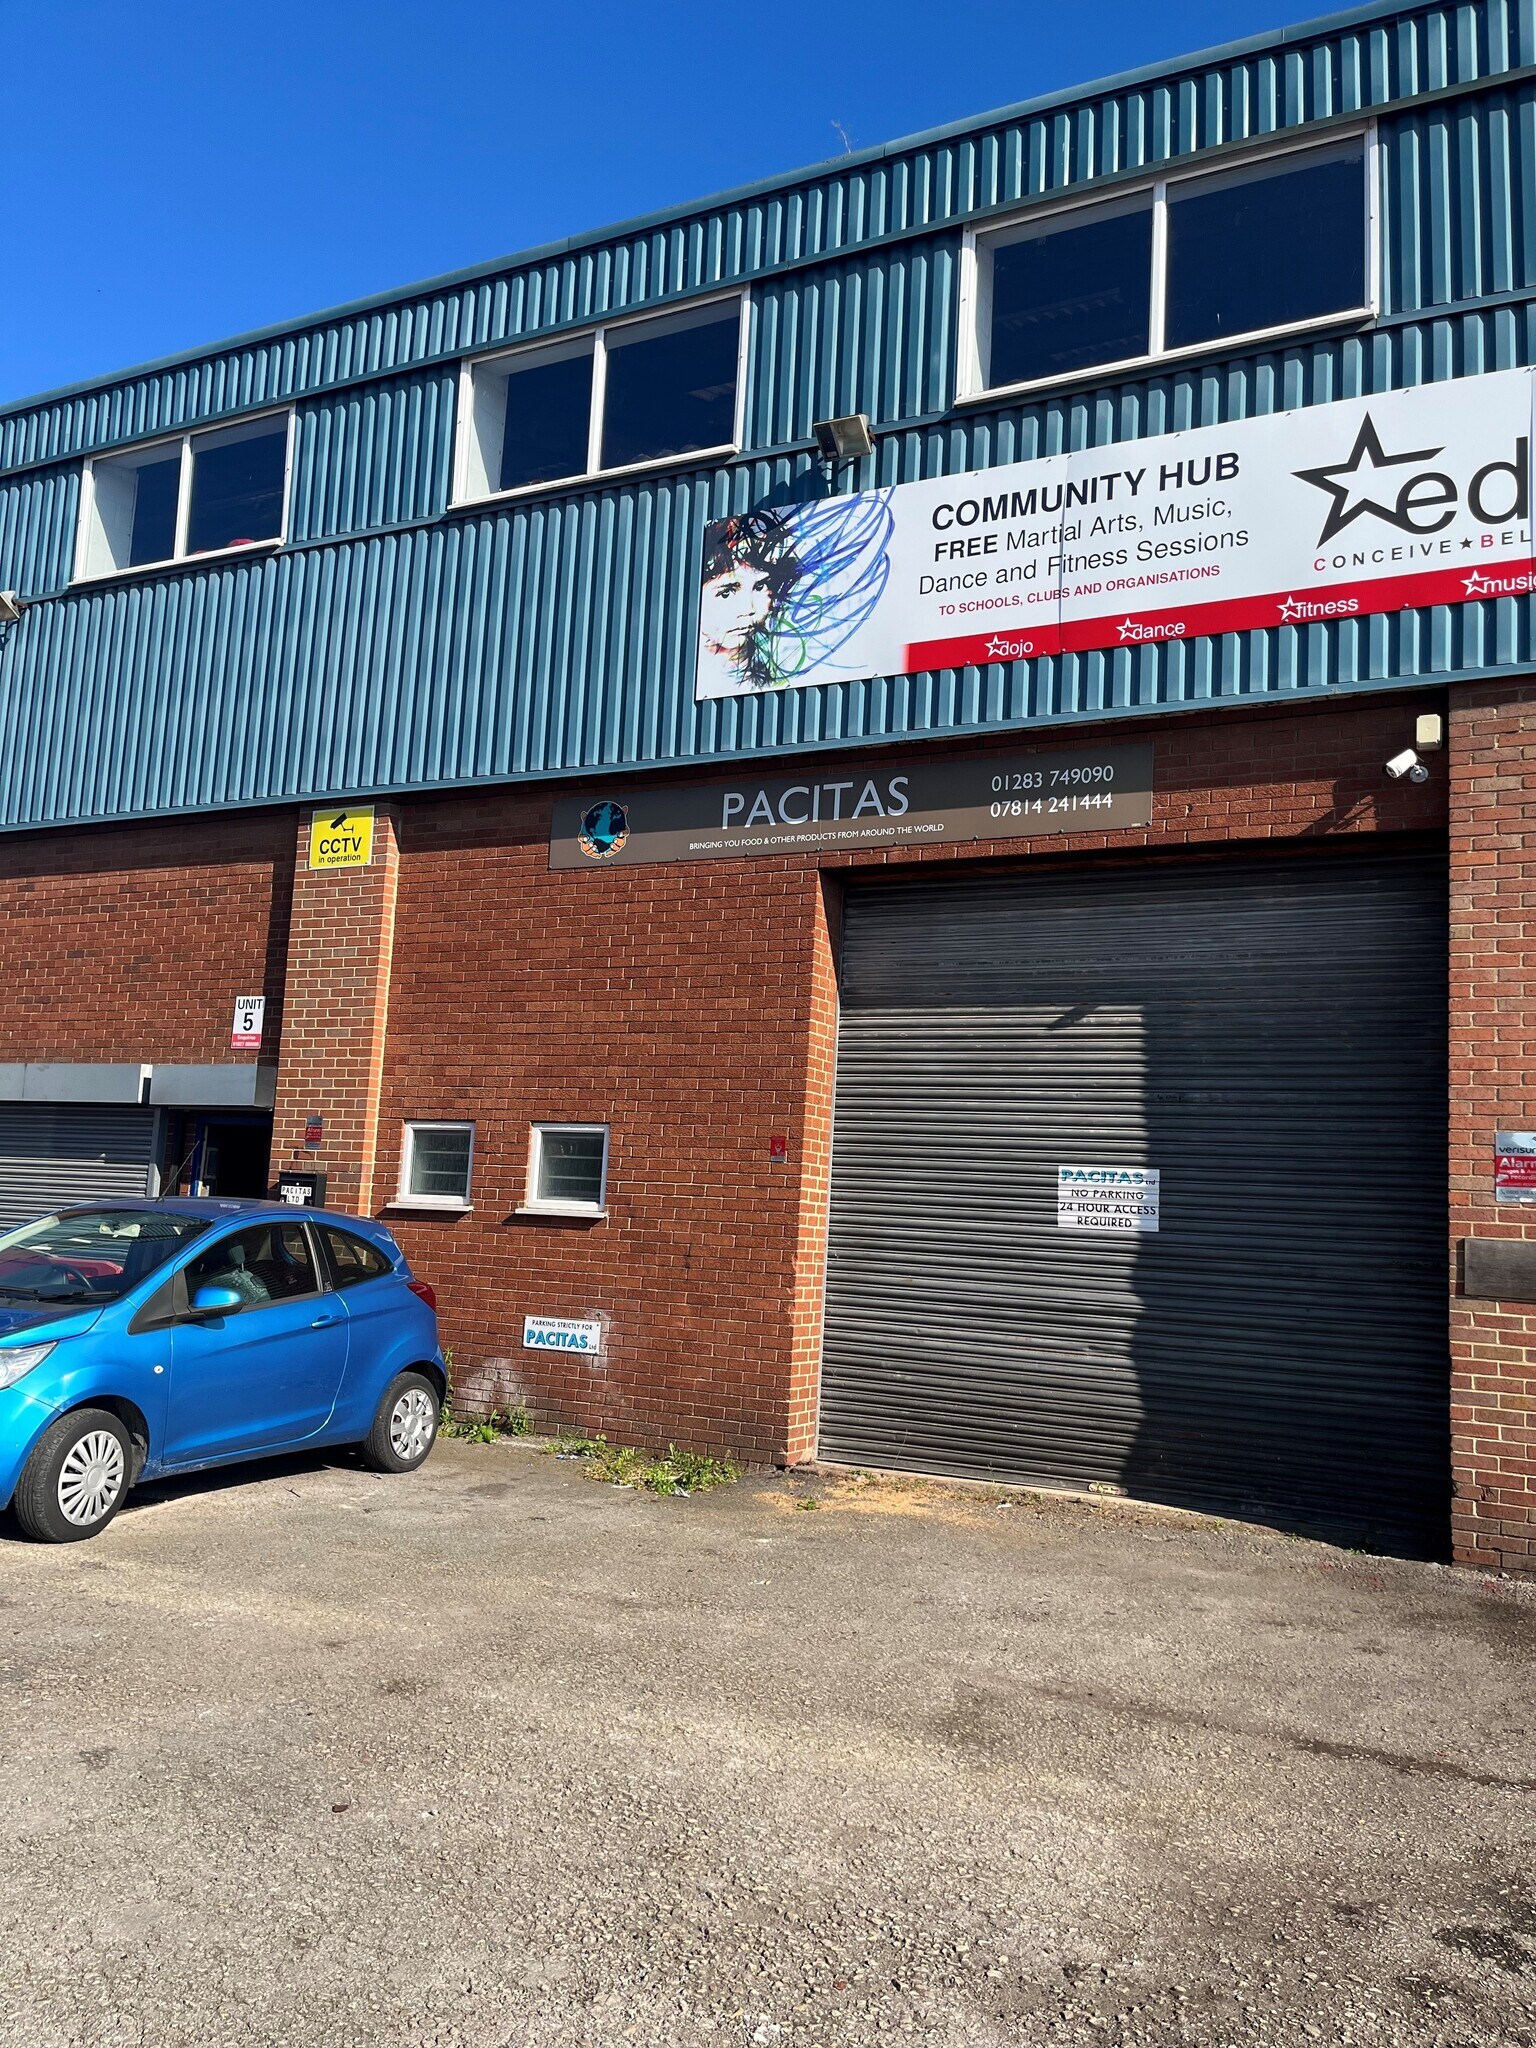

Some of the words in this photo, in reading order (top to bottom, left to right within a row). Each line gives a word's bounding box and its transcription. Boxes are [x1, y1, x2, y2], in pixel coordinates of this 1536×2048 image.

[932, 468, 1147, 531] COMMUNITY
[1159, 452, 1240, 491] HUB
[934, 534, 998, 562] FREE
[1006, 520, 1082, 551] Martial
[1090, 513, 1144, 537] Arts,
[1154, 497, 1233, 527] Music,
[919, 570, 987, 595] Dance
[995, 560, 1037, 584] and
[1047, 549, 1127, 577] Fitness
[1136, 529, 1249, 562] Sessions
[1314, 540, 1452, 571] CONCEIVE
[939, 603, 955, 616] TO
[958, 596, 1024, 615] SCHOOLS,
[1027, 587, 1070, 604] CLUBS
[1074, 582, 1102, 597] AND
[1105, 565, 1221, 593] ORGANISATIONS
[1295, 597, 1359, 618] fitness
[1132, 620, 1187, 640] dance
[999, 639, 1034, 658] dojo
[991, 772, 1043, 792] 01283
[1050, 765, 1114, 787] 749090
[721, 777, 909, 829] PACITAS
[990, 797, 1042, 818] 07814
[1048, 792, 1113, 813] 241444
[319, 836, 362, 855] CCTV
[689, 840, 722, 850] BRINGING
[724, 839, 740, 848] YOU
[741, 837, 763, 846] FOOD
[770, 835, 796, 844] OTHER
[796, 832, 837, 842] PRODUCTS
[837, 830, 859, 839] FROM
[860, 827, 895, 837] AROUND
[896, 825, 912, 834] THE
[914, 823, 944, 832] WORLD
[326, 854, 361, 865] operation
[237, 998, 263, 1010] UNIT
[242, 1012, 254, 1031] 5
[1060, 1169, 1144, 1185] PACITAS
[281, 1186, 311, 1195] PACITAS
[1071, 1189, 1089, 1198] NO
[1093, 1189, 1144, 1200] PARKING
[1059, 1202, 1074, 1211] 24
[1077, 1203, 1110, 1213] HOUR
[1113, 1204, 1156, 1215] ACCESS
[1077, 1216, 1132, 1228] REQUIRED
[532, 1319, 556, 1328] PARKING
[557, 1321, 580, 1330] STRICTLY
[581, 1323, 593, 1331] FOR
[526, 1328, 588, 1350] PACITAS
